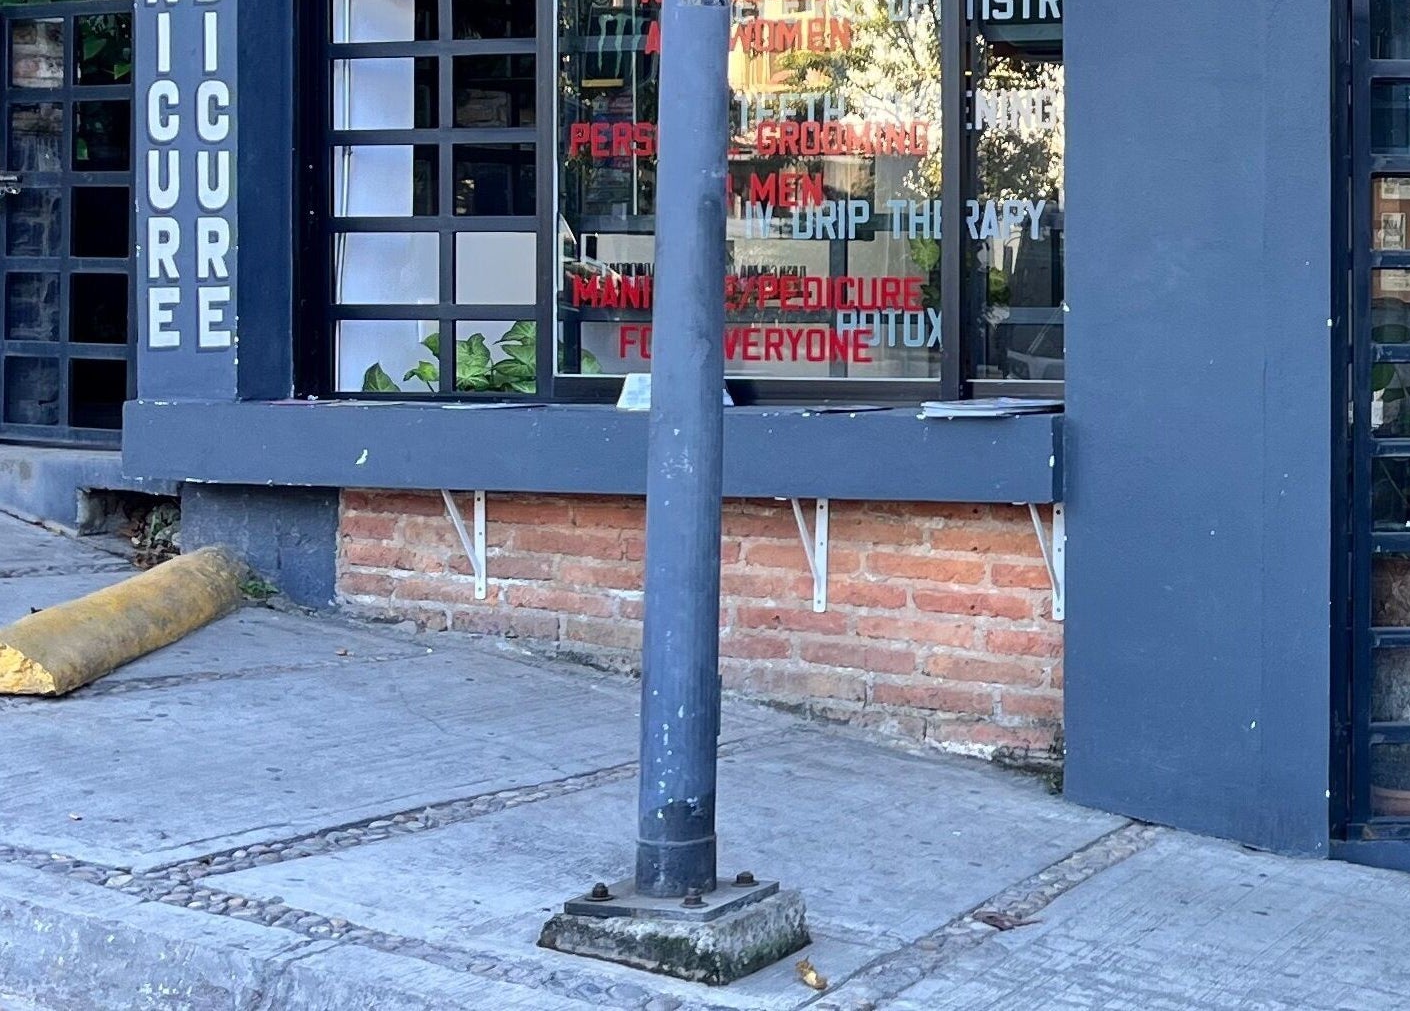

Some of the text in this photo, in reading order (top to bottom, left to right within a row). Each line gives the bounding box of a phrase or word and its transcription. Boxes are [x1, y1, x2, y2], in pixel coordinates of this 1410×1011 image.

[757, 120, 929, 156] GROOMING
[750, 173, 823, 207] MEN
[745, 201, 773, 239] IV
[795, 200, 870, 239] DRIP
[724, 327, 872, 363] VERYONE
